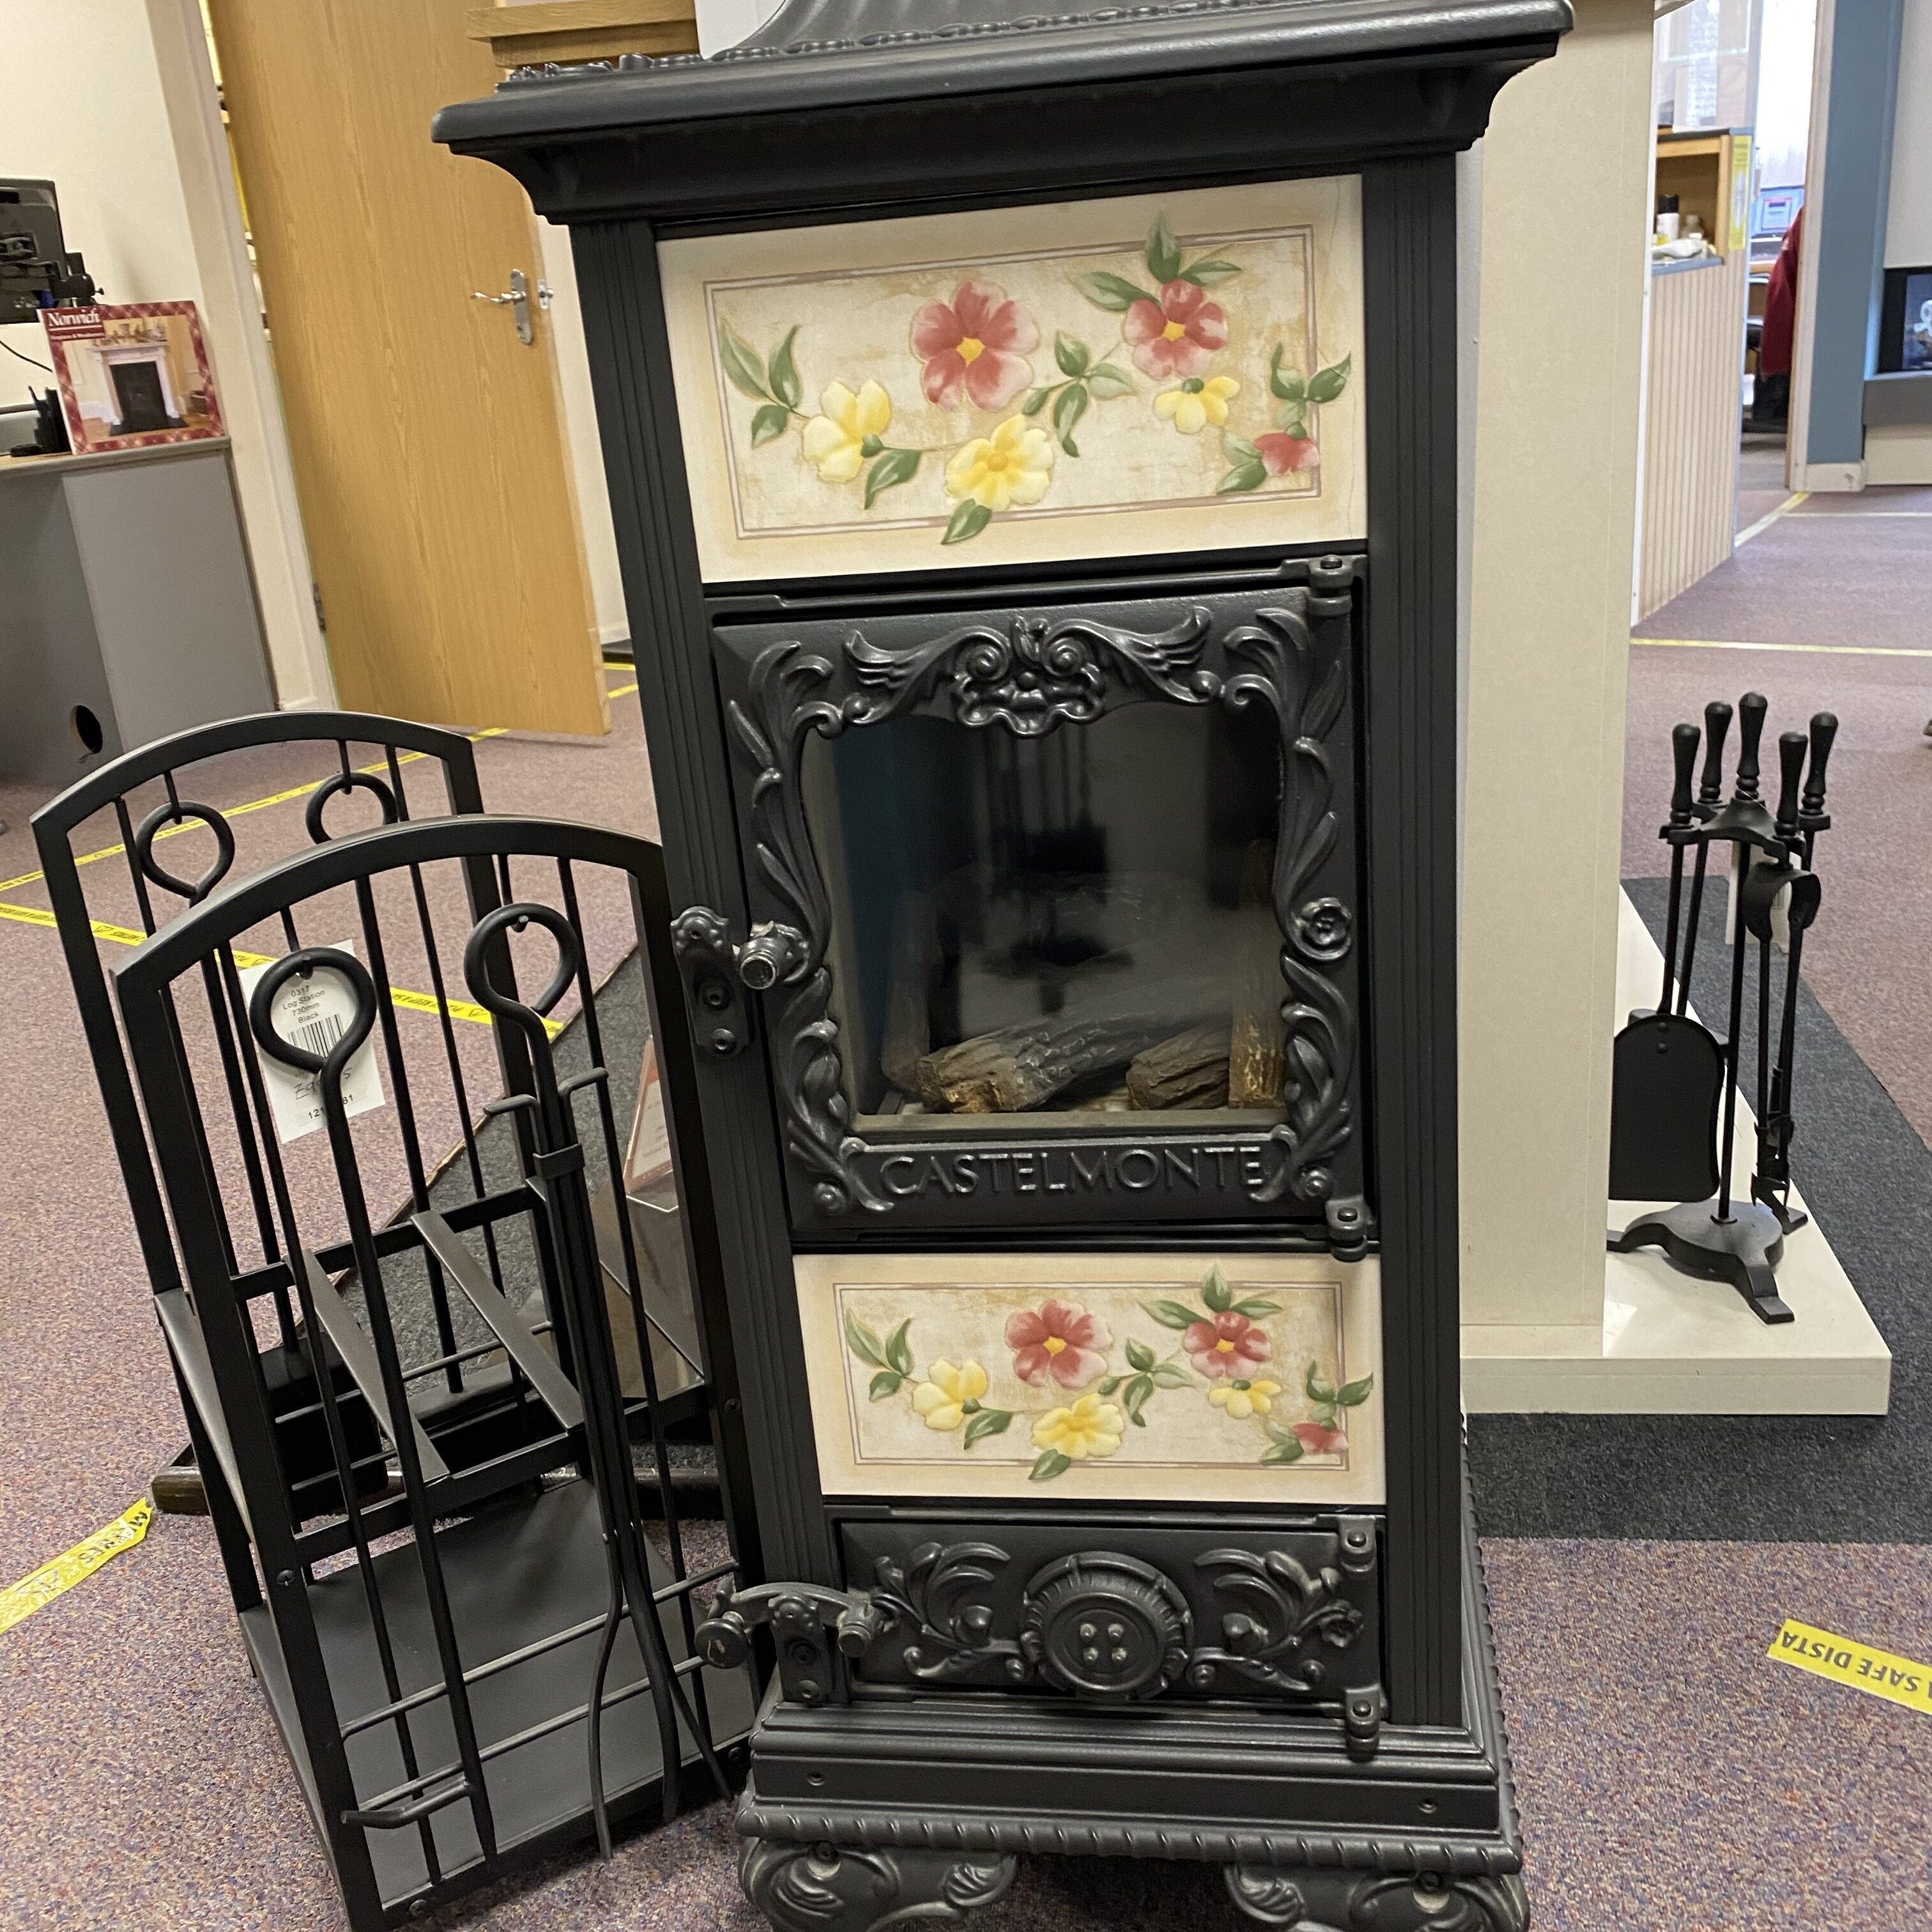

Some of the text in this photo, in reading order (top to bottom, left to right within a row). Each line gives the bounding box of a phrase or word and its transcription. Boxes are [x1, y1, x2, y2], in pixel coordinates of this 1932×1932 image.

[282, 990, 325, 1009] Log Station
[291, 1002, 319, 1016] 730mm
[298, 1011, 319, 1023] Black
[880, 1147, 1263, 1194] CASTELMONTE
[1781, 1631, 1853, 1669] DISTA
[1857, 1658, 1921, 1692] SAFE
